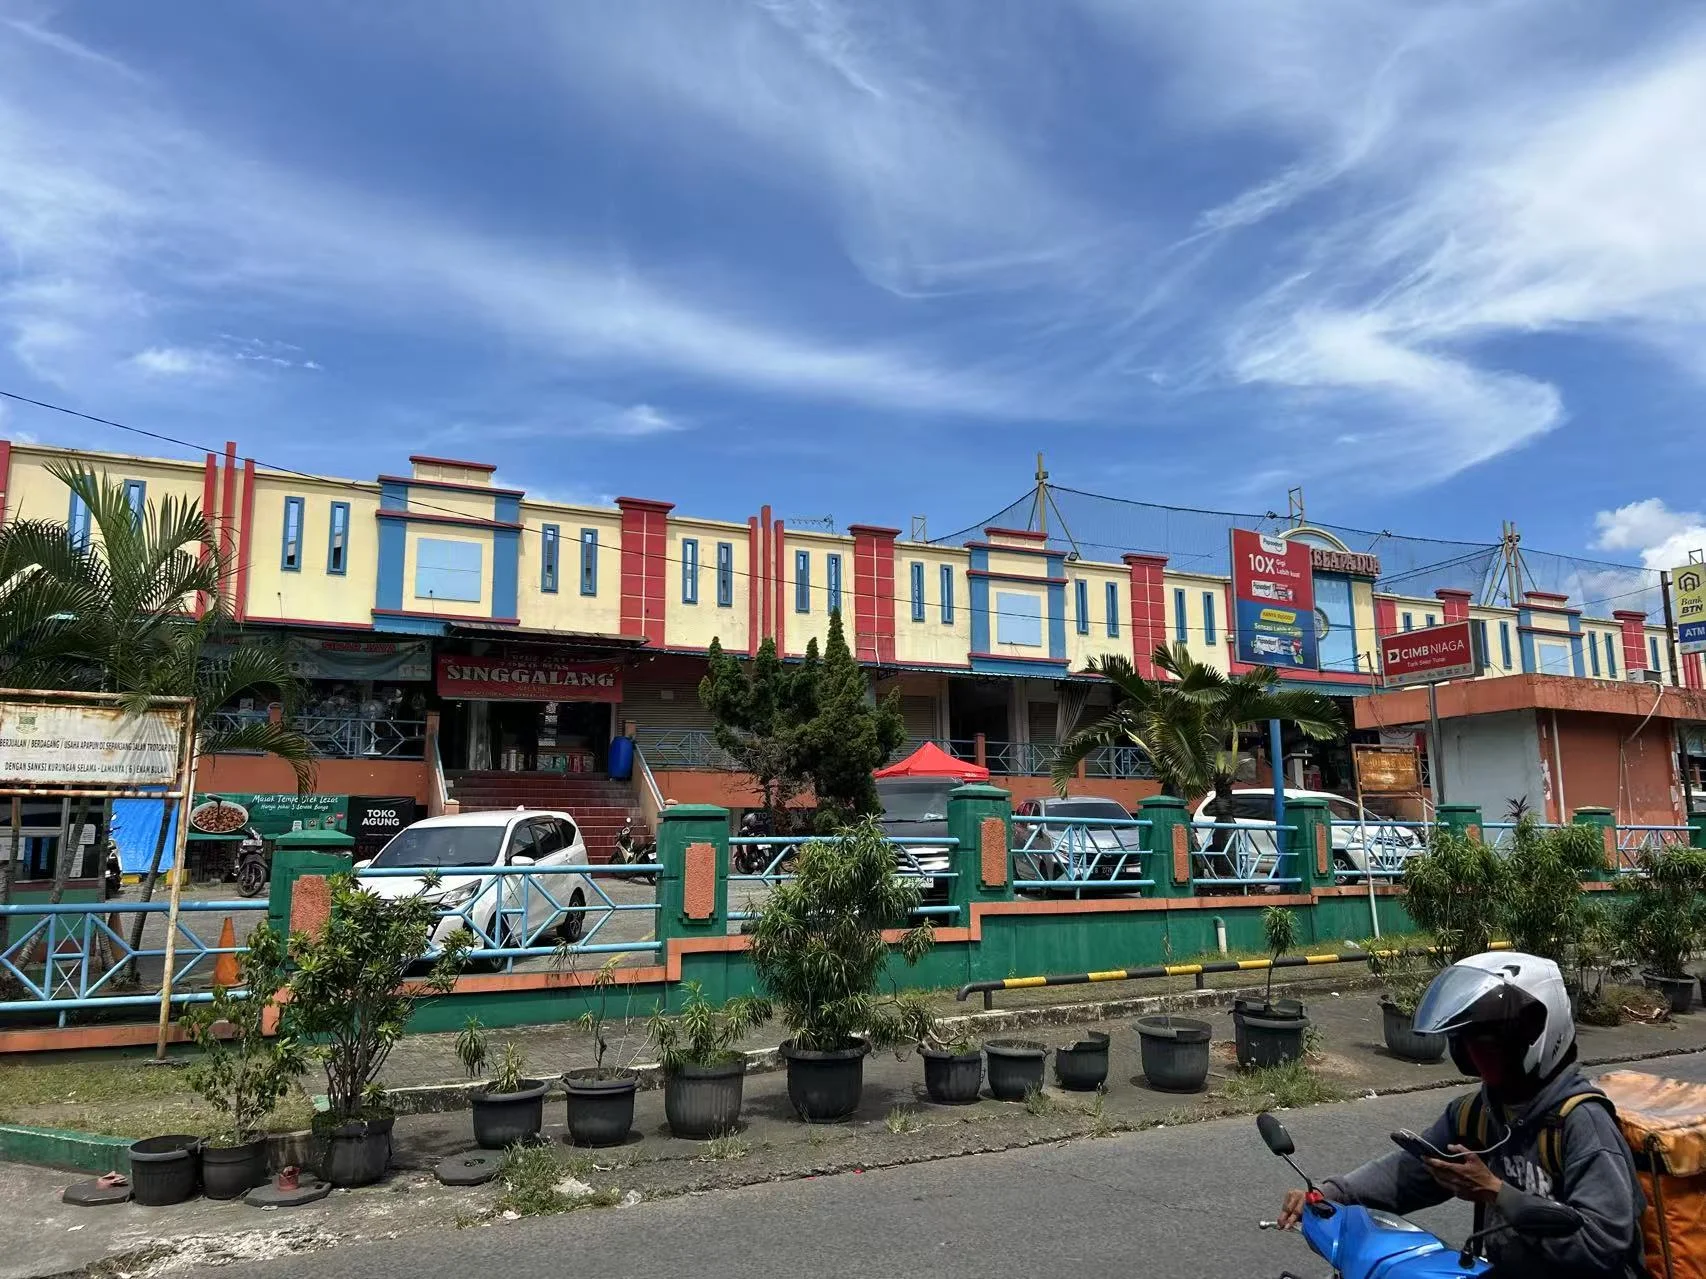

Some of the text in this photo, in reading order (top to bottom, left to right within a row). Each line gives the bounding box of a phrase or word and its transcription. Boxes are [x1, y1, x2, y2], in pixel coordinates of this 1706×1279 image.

[1248, 553, 1275, 575] 10X
[1681, 596, 1703, 606] Bank
[1682, 604, 1704, 614] BTN
[1685, 626, 1706, 637] ATM
[1401, 639, 1465, 660] CIMB NIAGA
[446, 664, 615, 688] SINGGALANG
[31, 739, 60, 749] BERDAGANG
[64, 740, 79, 749] USAHA
[80, 741, 99, 750] APAPUN
[5, 762, 26, 771] DENGAN
[28, 762, 47, 771] SANKSI
[48, 763, 76, 772] KURUNGAN
[77, 763, 97, 772] SELAMA
[366, 809, 396, 818] TOKO
[361, 817, 400, 826] AGUNG
